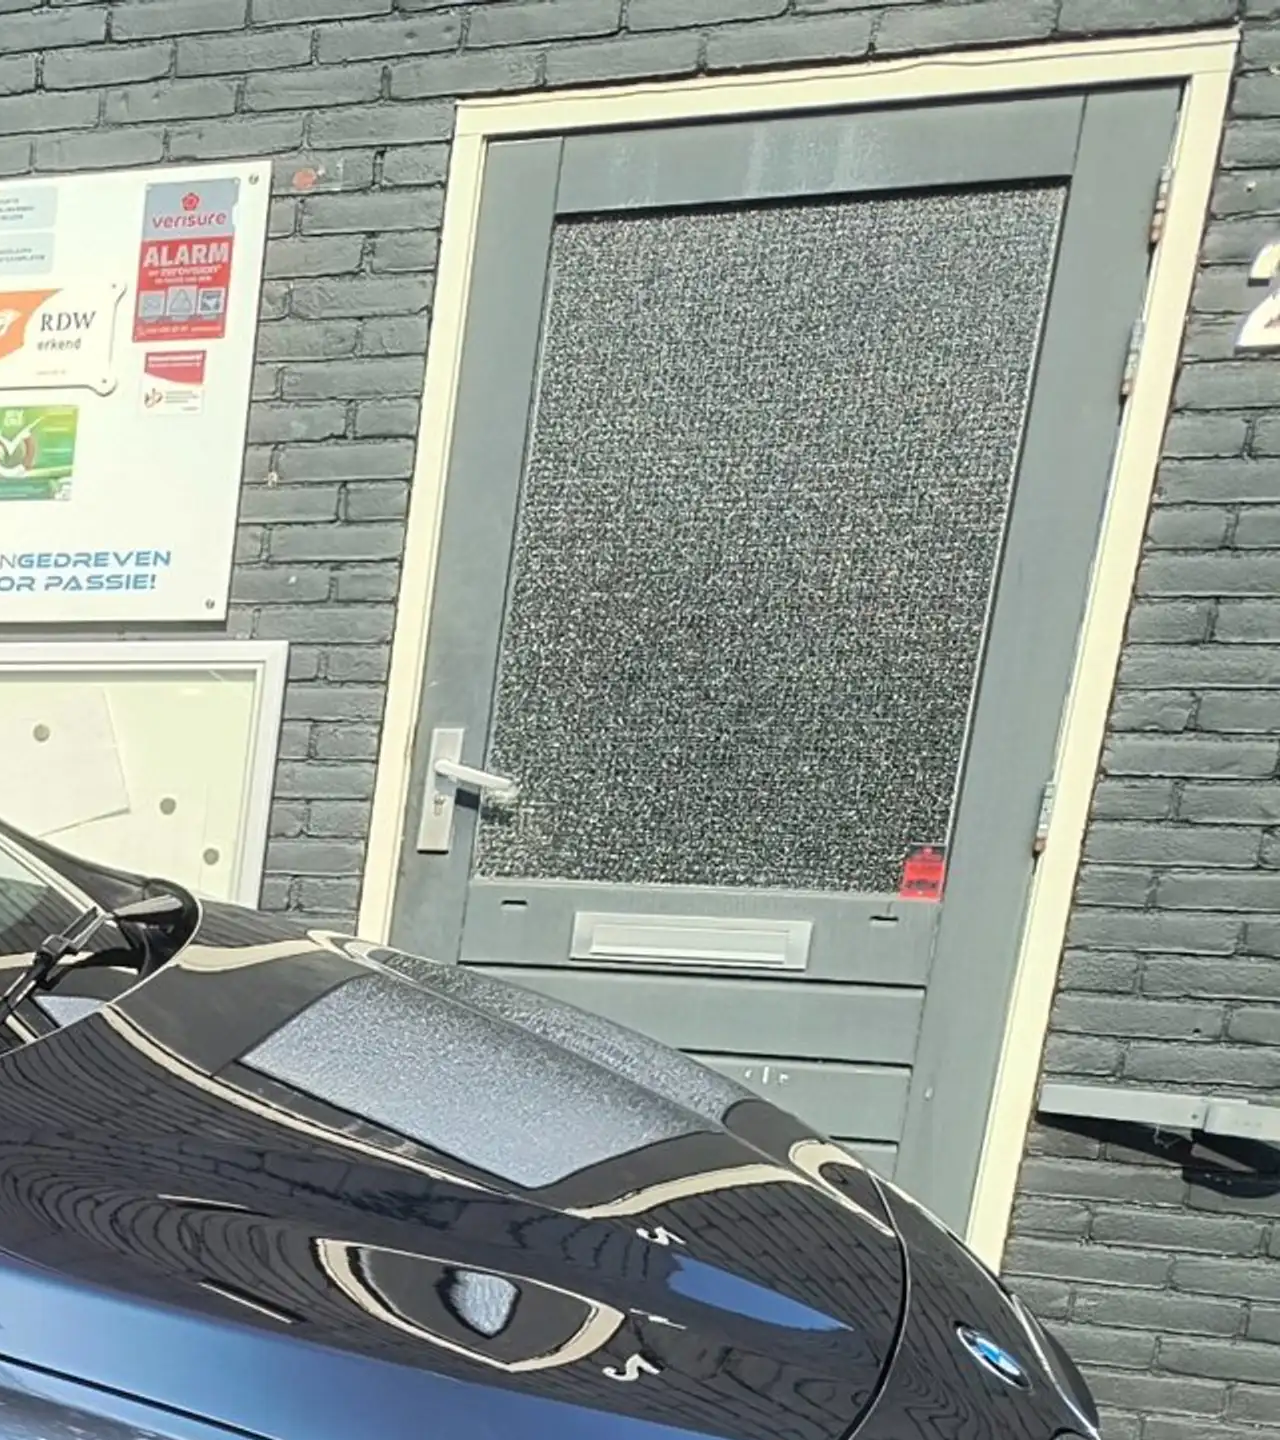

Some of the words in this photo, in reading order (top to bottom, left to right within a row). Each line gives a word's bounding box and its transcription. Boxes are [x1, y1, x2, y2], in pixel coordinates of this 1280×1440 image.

[152, 211, 227, 229] verisure
[144, 242, 230, 267] ALARM
[40, 310, 97, 332] RDW
[37, 337, 81, 351] erkend
[44, 574, 158, 592] PASSIE!
